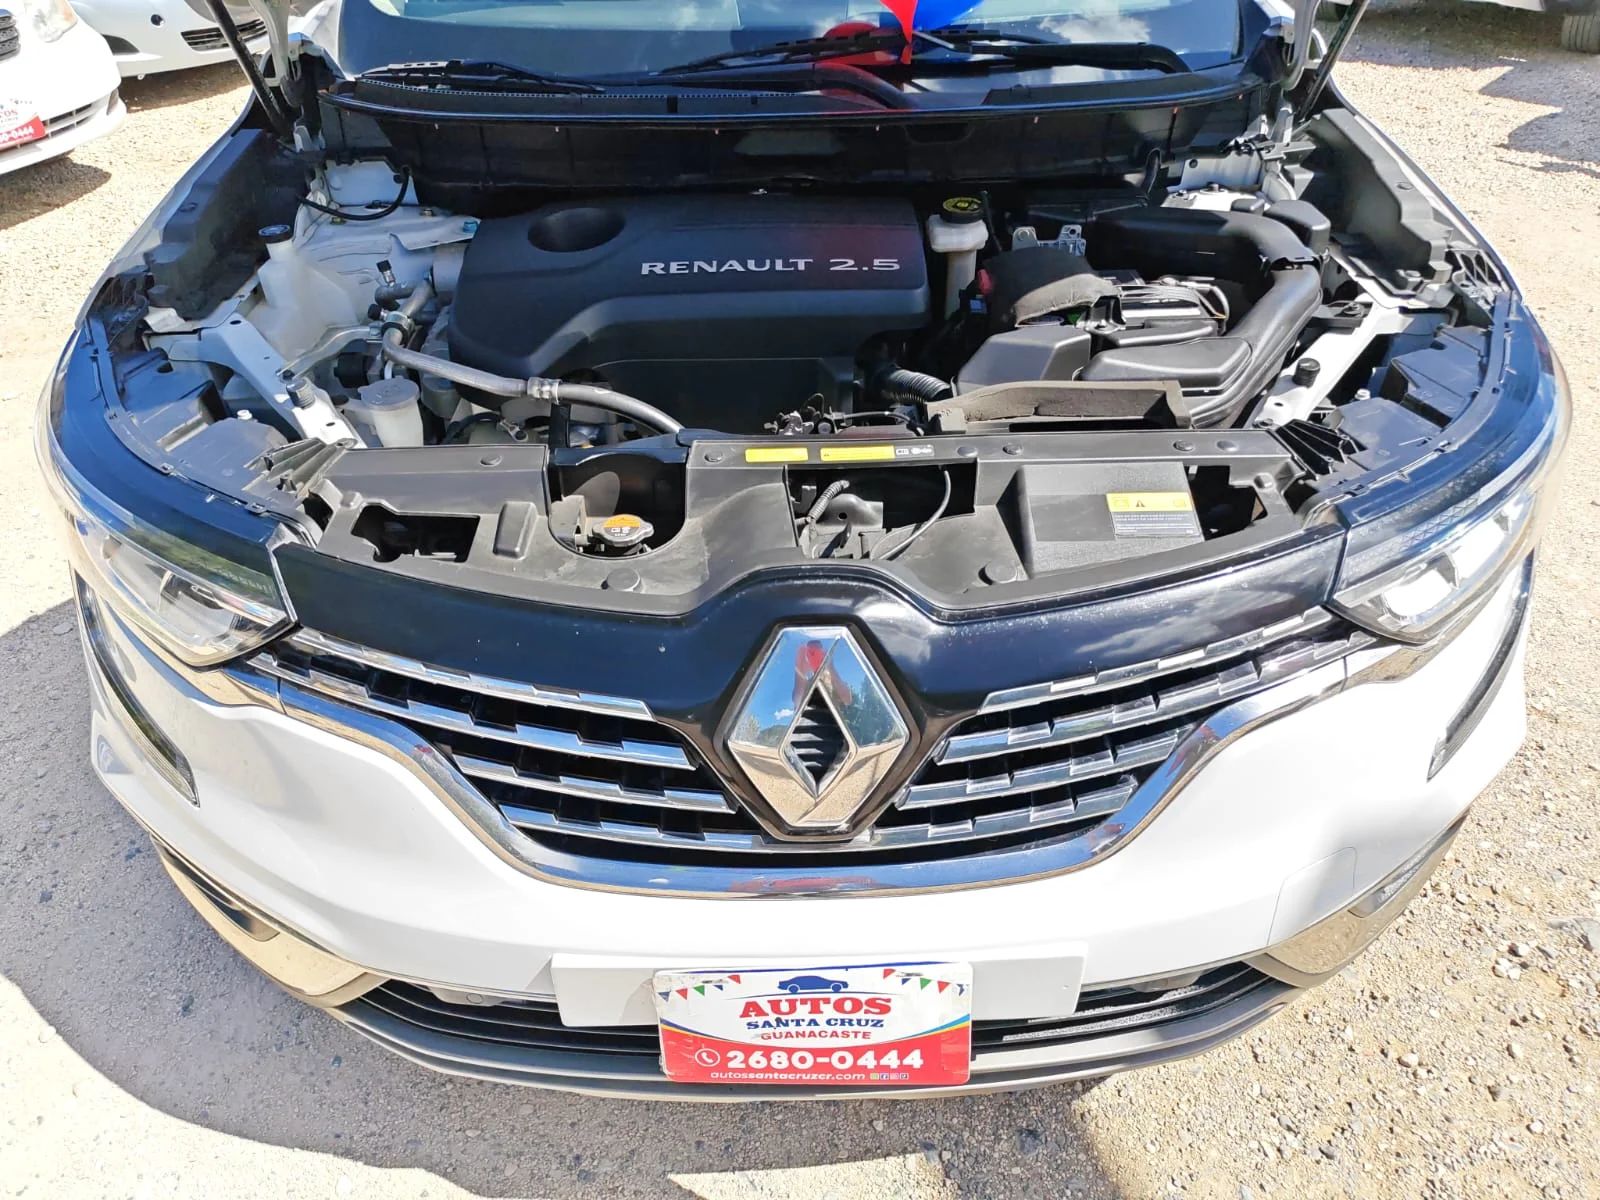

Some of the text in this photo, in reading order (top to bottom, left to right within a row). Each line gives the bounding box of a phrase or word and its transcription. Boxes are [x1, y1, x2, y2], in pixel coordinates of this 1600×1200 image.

[640, 257, 901, 275] RENAULT 2.5
[739, 997, 892, 1018] AUTOS
[745, 1017, 885, 1030] SANTA CRUZ
[760, 1030, 872, 1041] GUANACASTE
[726, 1049, 924, 1070] 2680-0444
[710, 1071, 866, 1081] autossantacruzcr.com
